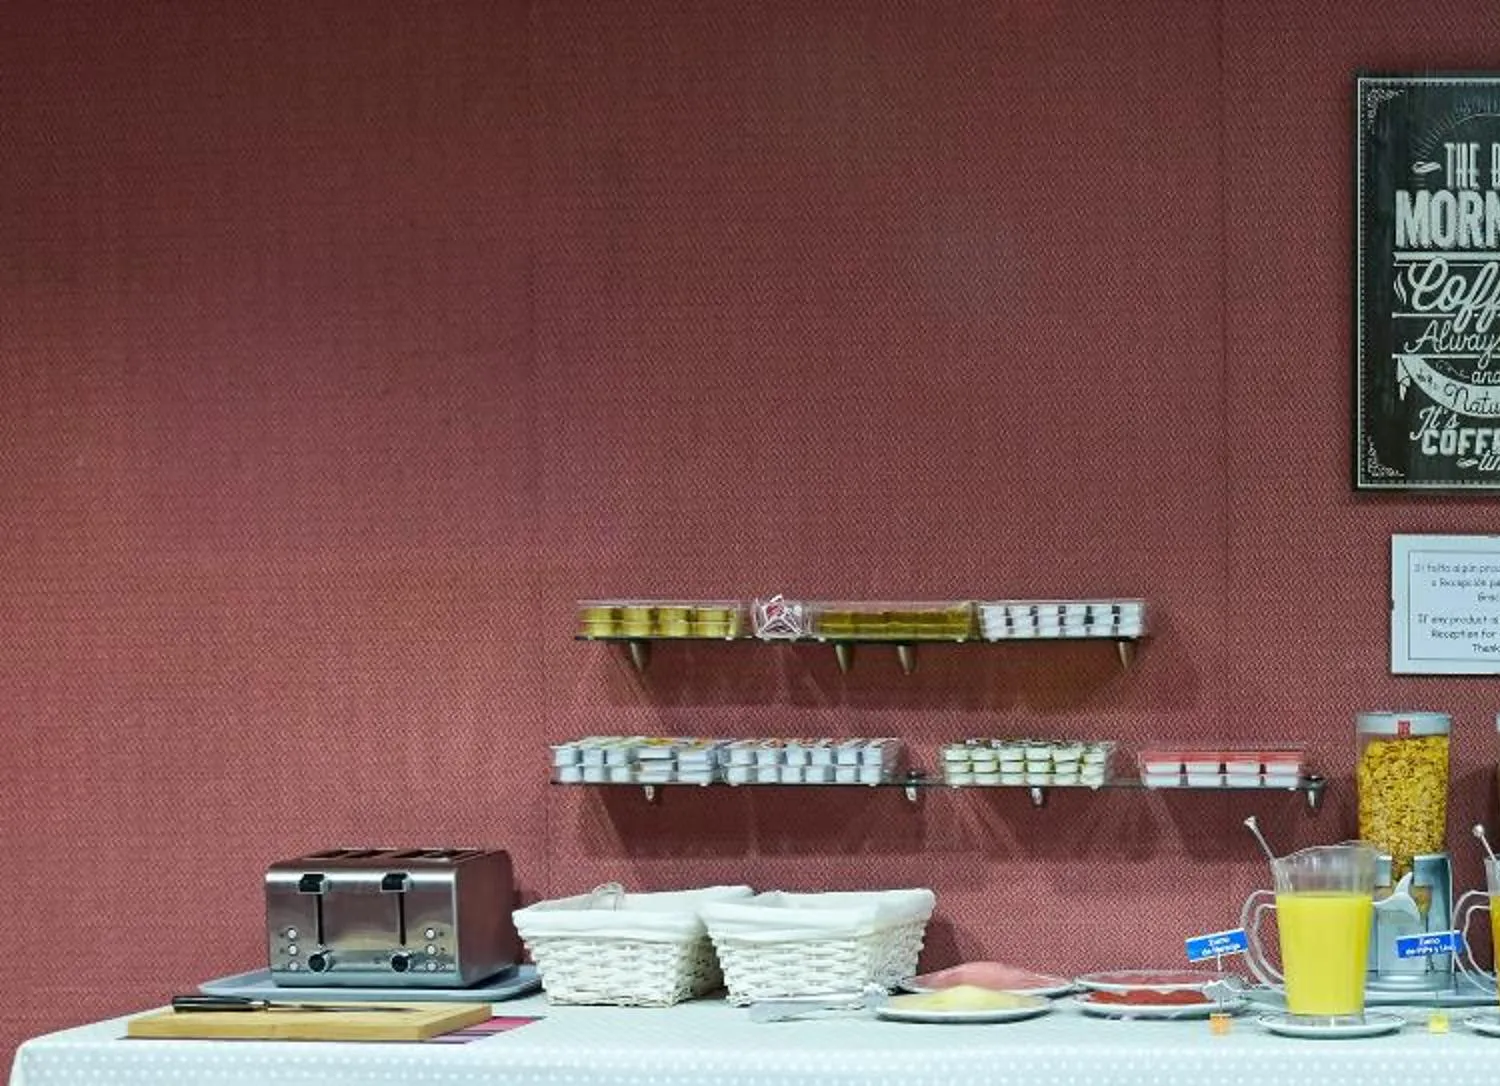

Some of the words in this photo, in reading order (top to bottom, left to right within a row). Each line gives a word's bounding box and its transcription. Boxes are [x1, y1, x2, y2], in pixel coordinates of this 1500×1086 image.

[1444, 142, 1480, 189] THE
[1410, 404, 1460, 441] It's
[1449, 613, 1488, 626] product
[1431, 628, 1479, 641] Reception
[1481, 628, 1496, 639] for
[1472, 643, 1500, 653] Thank
